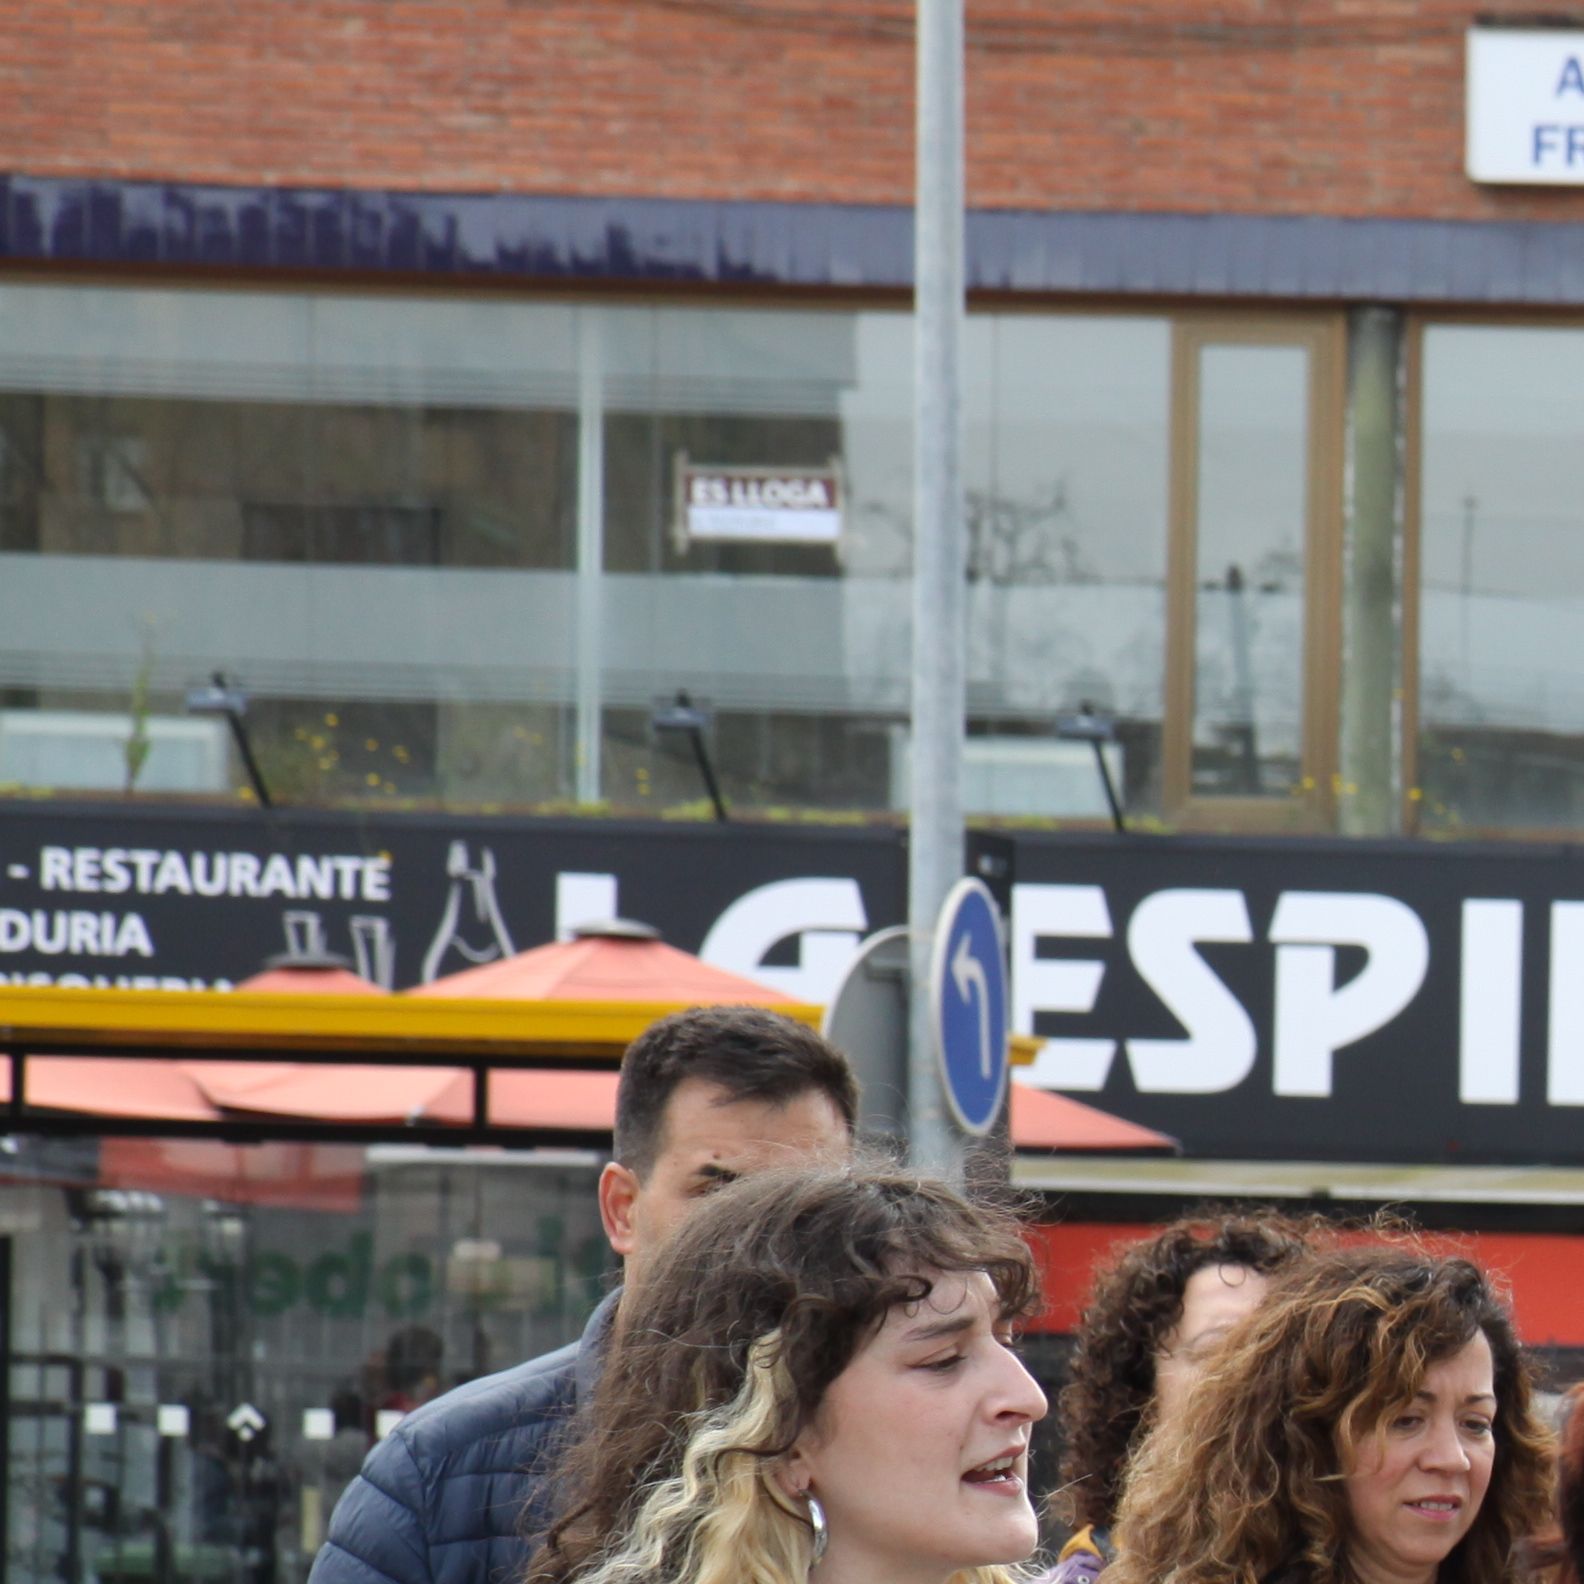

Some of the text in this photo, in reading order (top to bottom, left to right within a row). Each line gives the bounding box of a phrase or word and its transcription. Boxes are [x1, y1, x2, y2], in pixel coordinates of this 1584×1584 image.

[691, 477, 829, 509] ES LLOGA
[40, 846, 391, 900] RESTAURANTE
